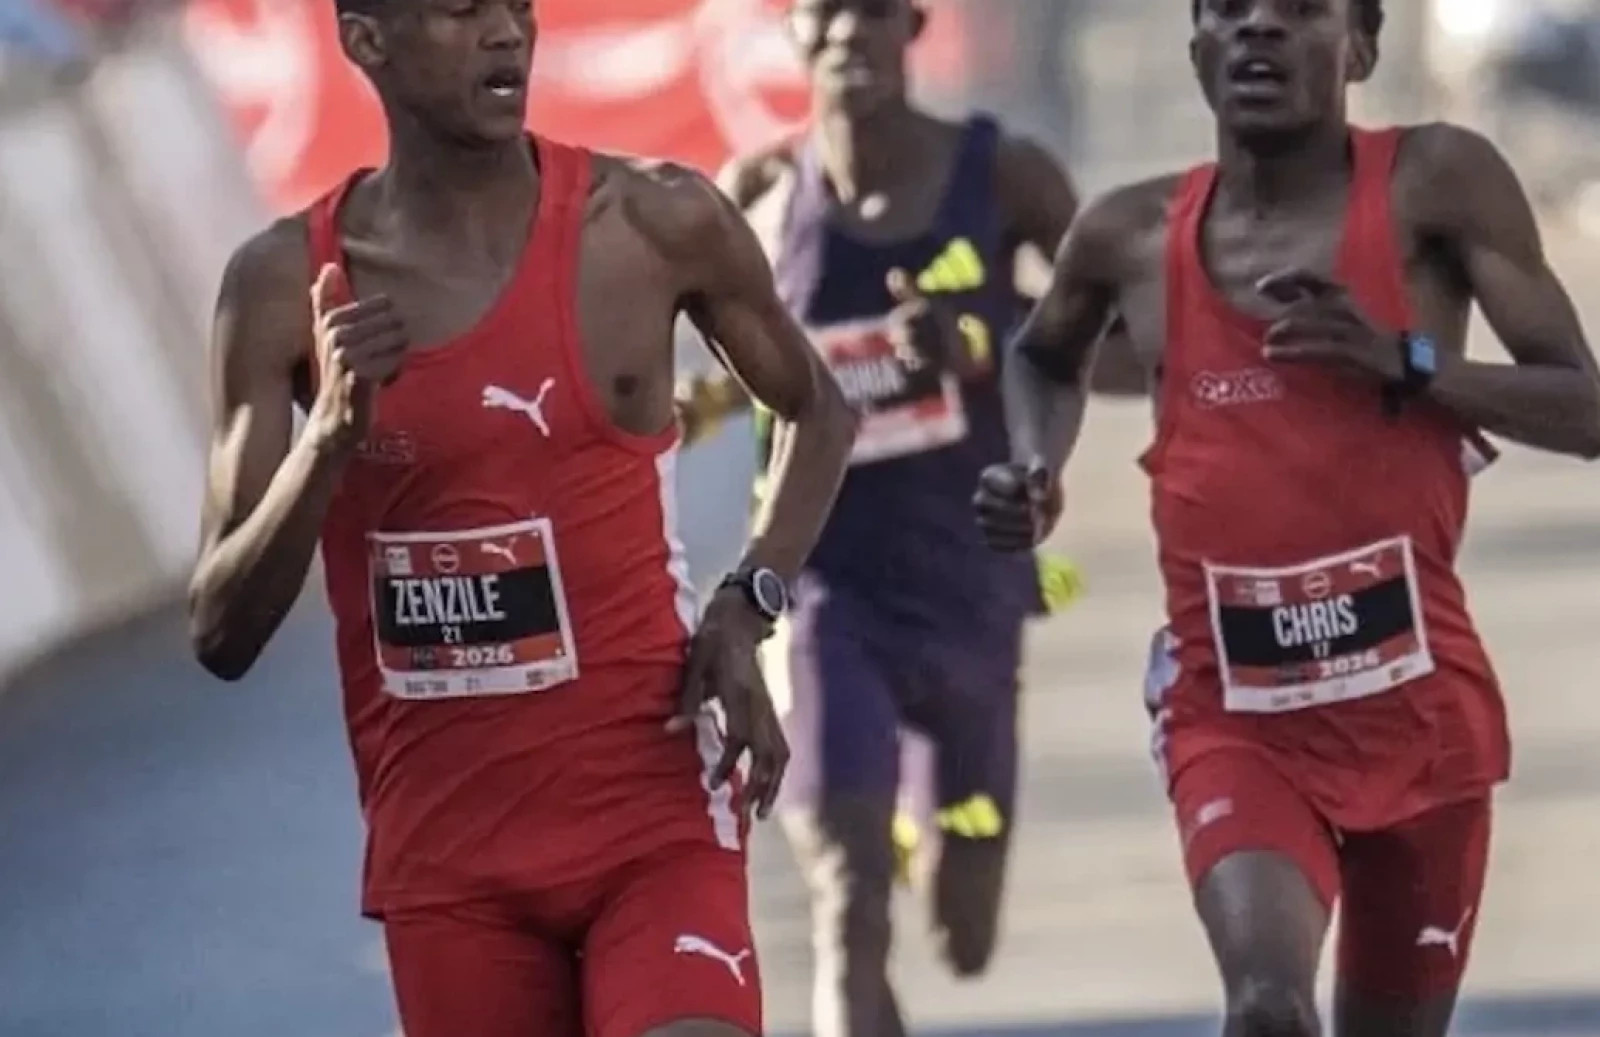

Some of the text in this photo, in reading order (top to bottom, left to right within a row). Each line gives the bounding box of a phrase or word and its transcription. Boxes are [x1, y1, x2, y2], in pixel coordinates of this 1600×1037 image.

[390, 574, 507, 625] ZENZILE
[441, 625, 463, 644] 21
[1272, 594, 1358, 648] CHRIS
[452, 644, 514, 667] 2026
